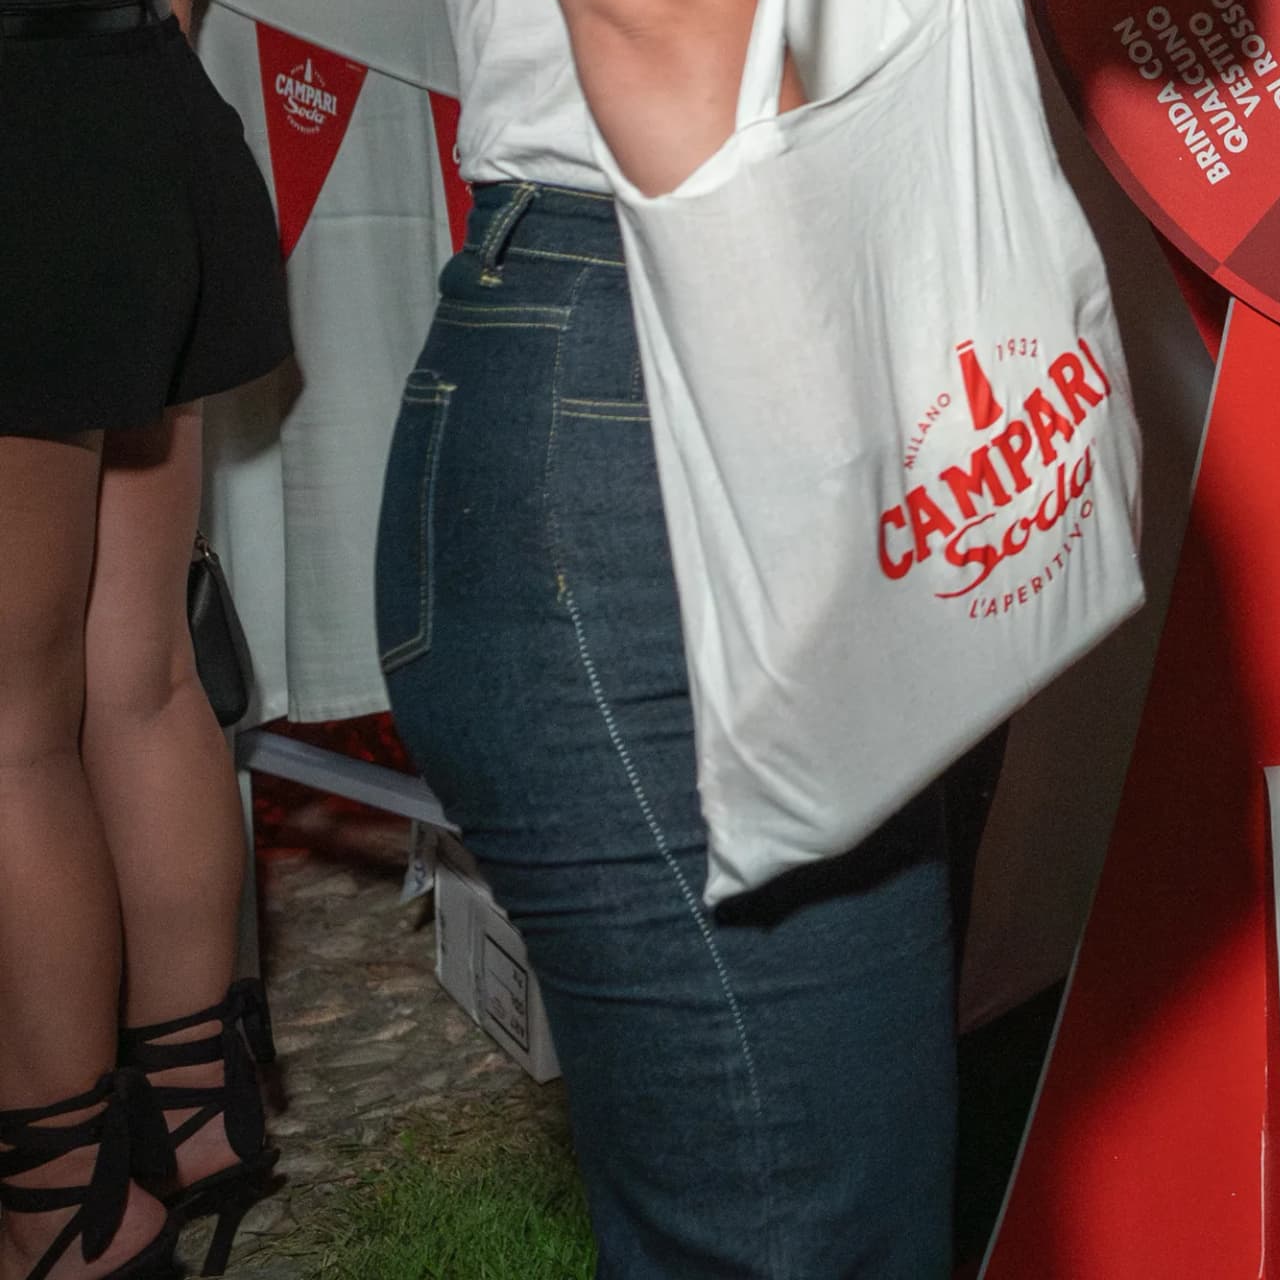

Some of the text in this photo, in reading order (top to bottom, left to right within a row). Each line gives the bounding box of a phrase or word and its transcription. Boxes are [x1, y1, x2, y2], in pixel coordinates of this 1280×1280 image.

[275, 73, 337, 116] CAMPARI
[283, 96, 325, 124] Soda
[1113, 16, 1230, 184] BRINDA CON
[1147, 7, 1247, 152] QUALCUNO
[1191, 14, 1260, 117] VESTITO
[996, 338, 1039, 361] 1932
[878, 337, 1111, 581] CAMPARI
[904, 392, 951, 469] MILANO
[934, 445, 1093, 599] Soda
